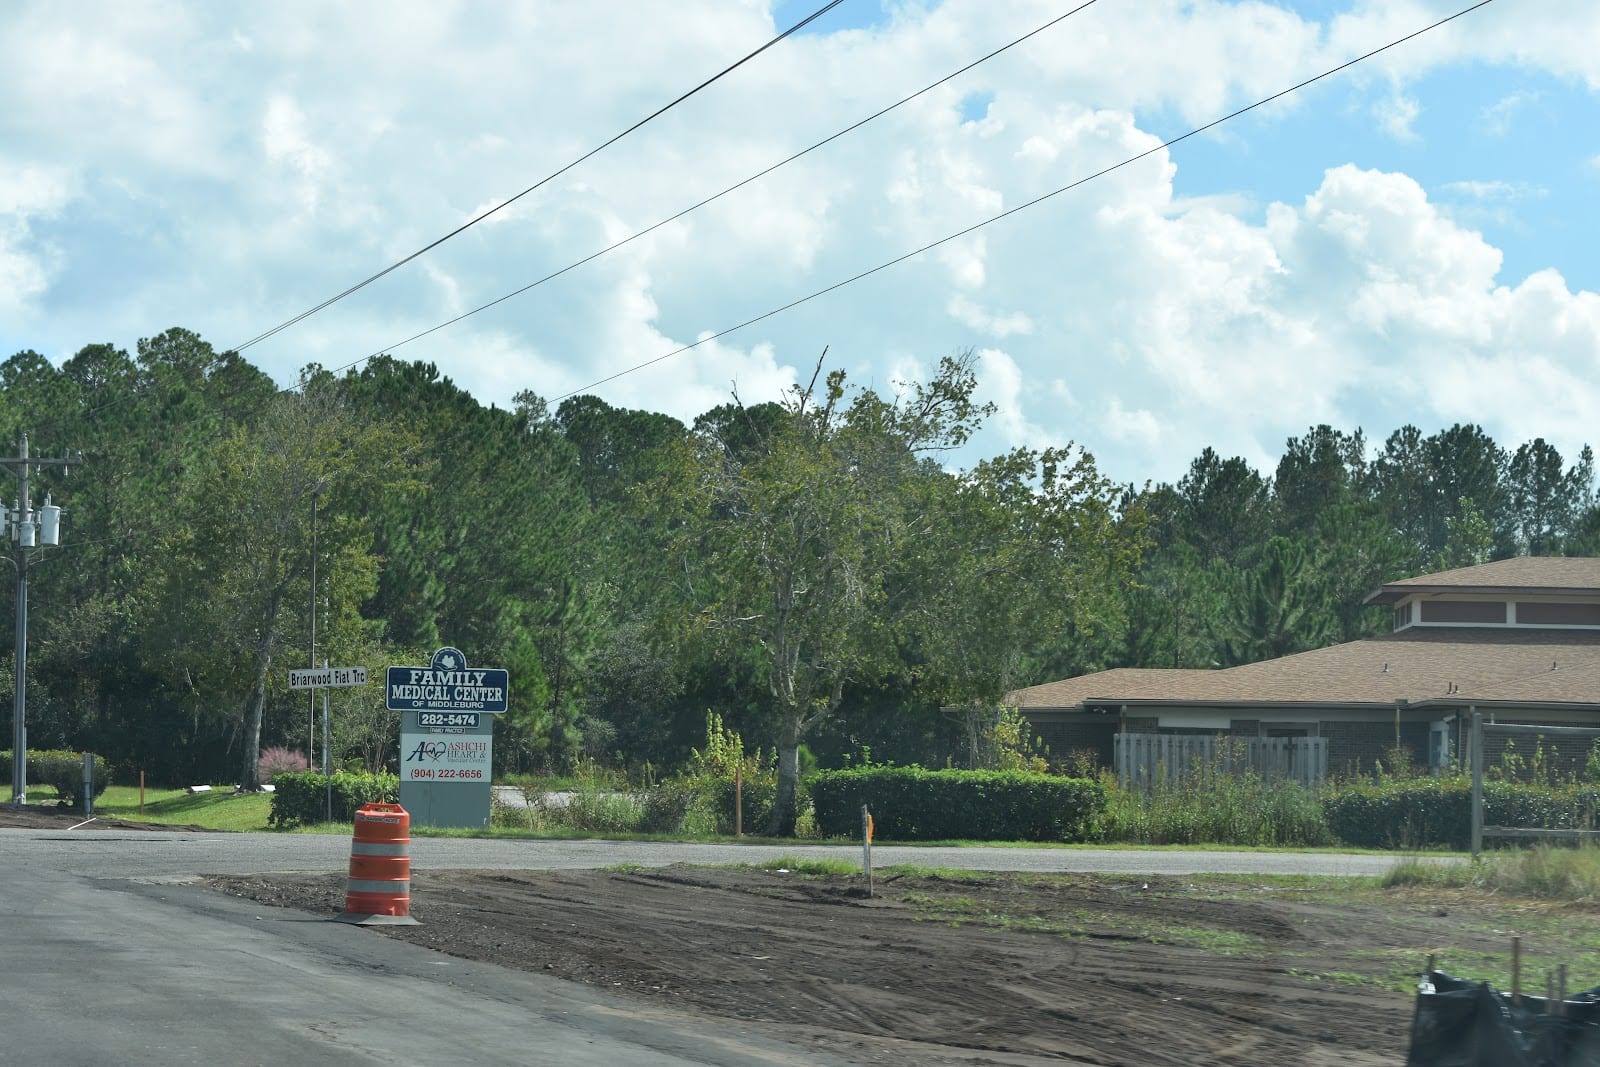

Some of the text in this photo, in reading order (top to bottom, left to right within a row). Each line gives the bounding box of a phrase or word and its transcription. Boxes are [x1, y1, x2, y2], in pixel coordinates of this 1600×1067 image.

[291, 669, 365, 686] Briarwood Flat Trc
[409, 670, 487, 686] FAMILY
[391, 685, 503, 702] MEDICAL CENTER
[428, 701, 484, 709] MIDDLEBURG
[421, 714, 475, 725] 282-5474
[447, 741, 487, 751] ASHCHI
[447, 750, 487, 759] HEART &
[410, 768, 482, 780] (904) 222-6656
